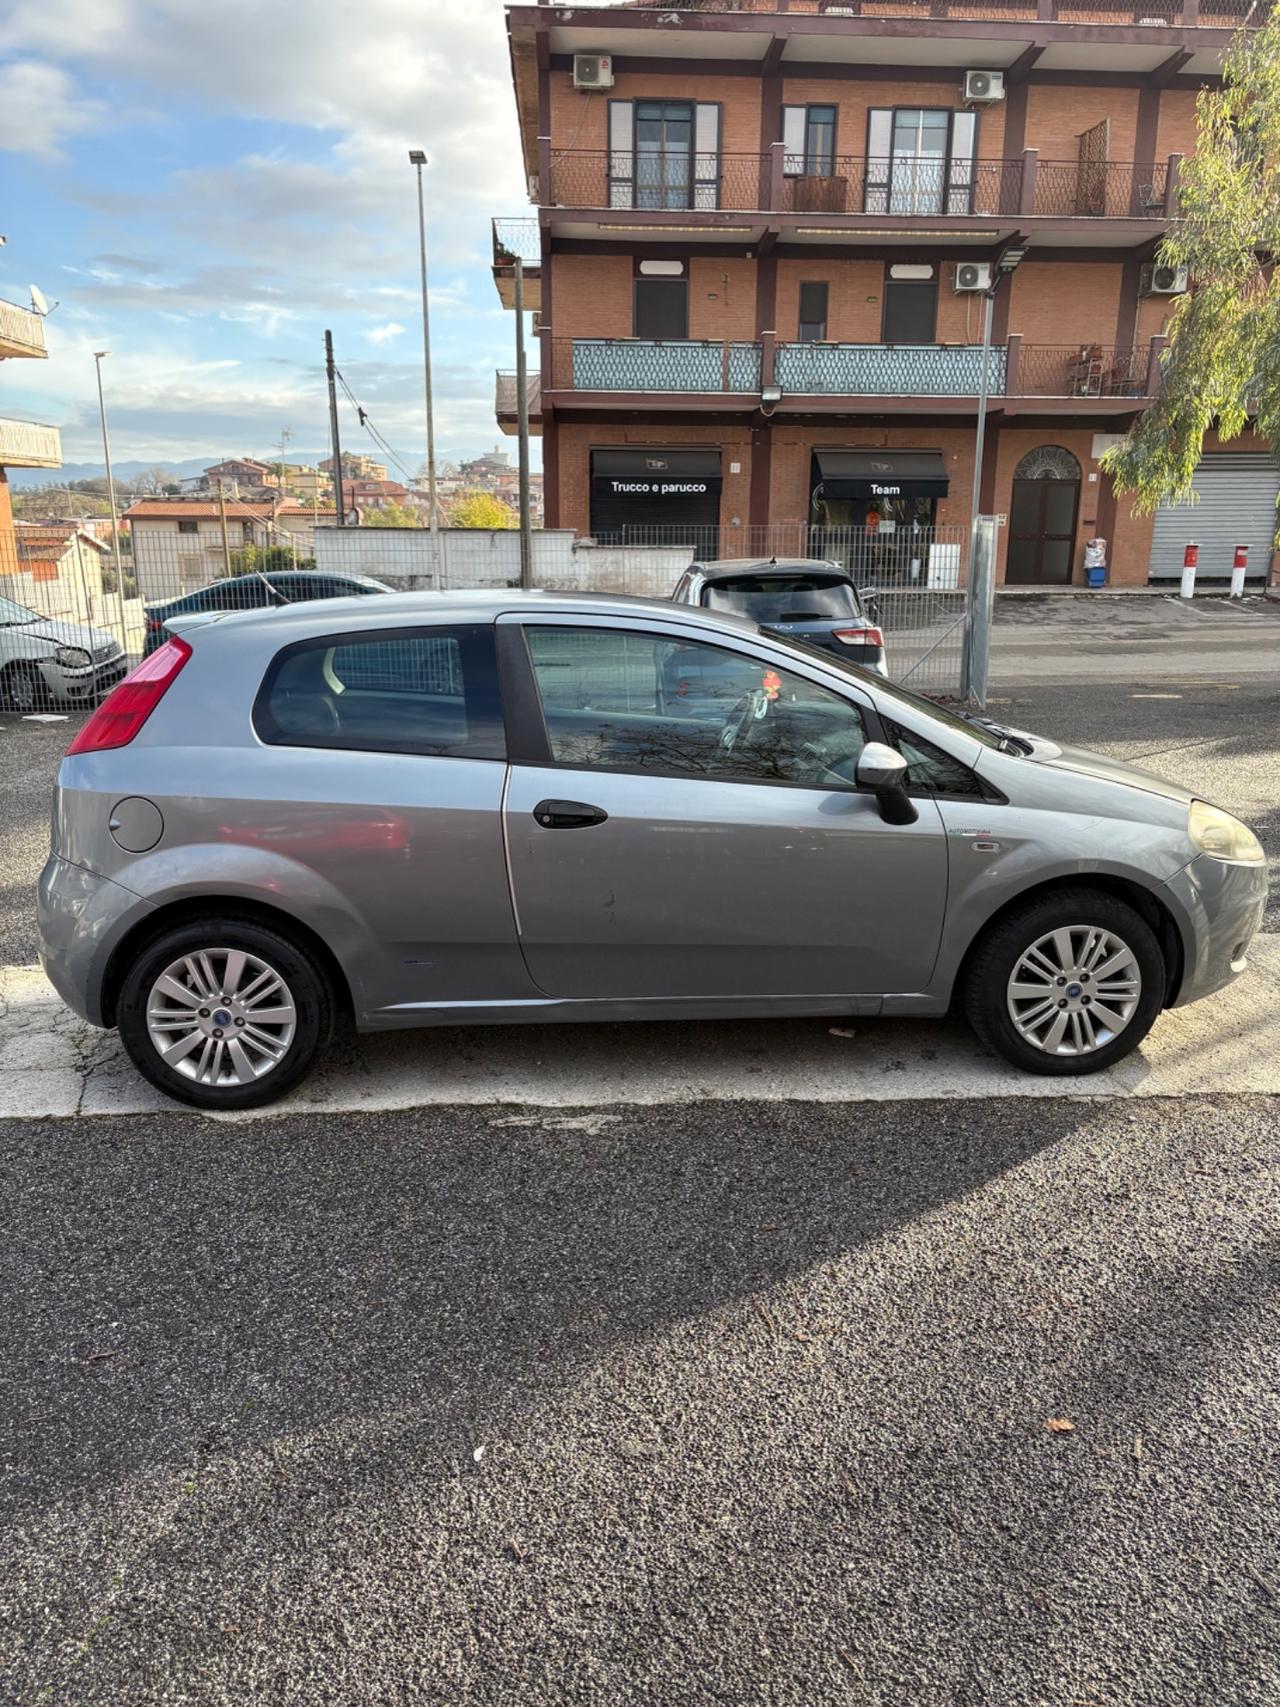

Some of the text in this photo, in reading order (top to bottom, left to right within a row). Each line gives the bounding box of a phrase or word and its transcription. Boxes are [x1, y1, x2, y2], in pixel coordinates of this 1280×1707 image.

[611, 481, 707, 494] Trucco e parucco
[871, 484, 901, 495] Team
